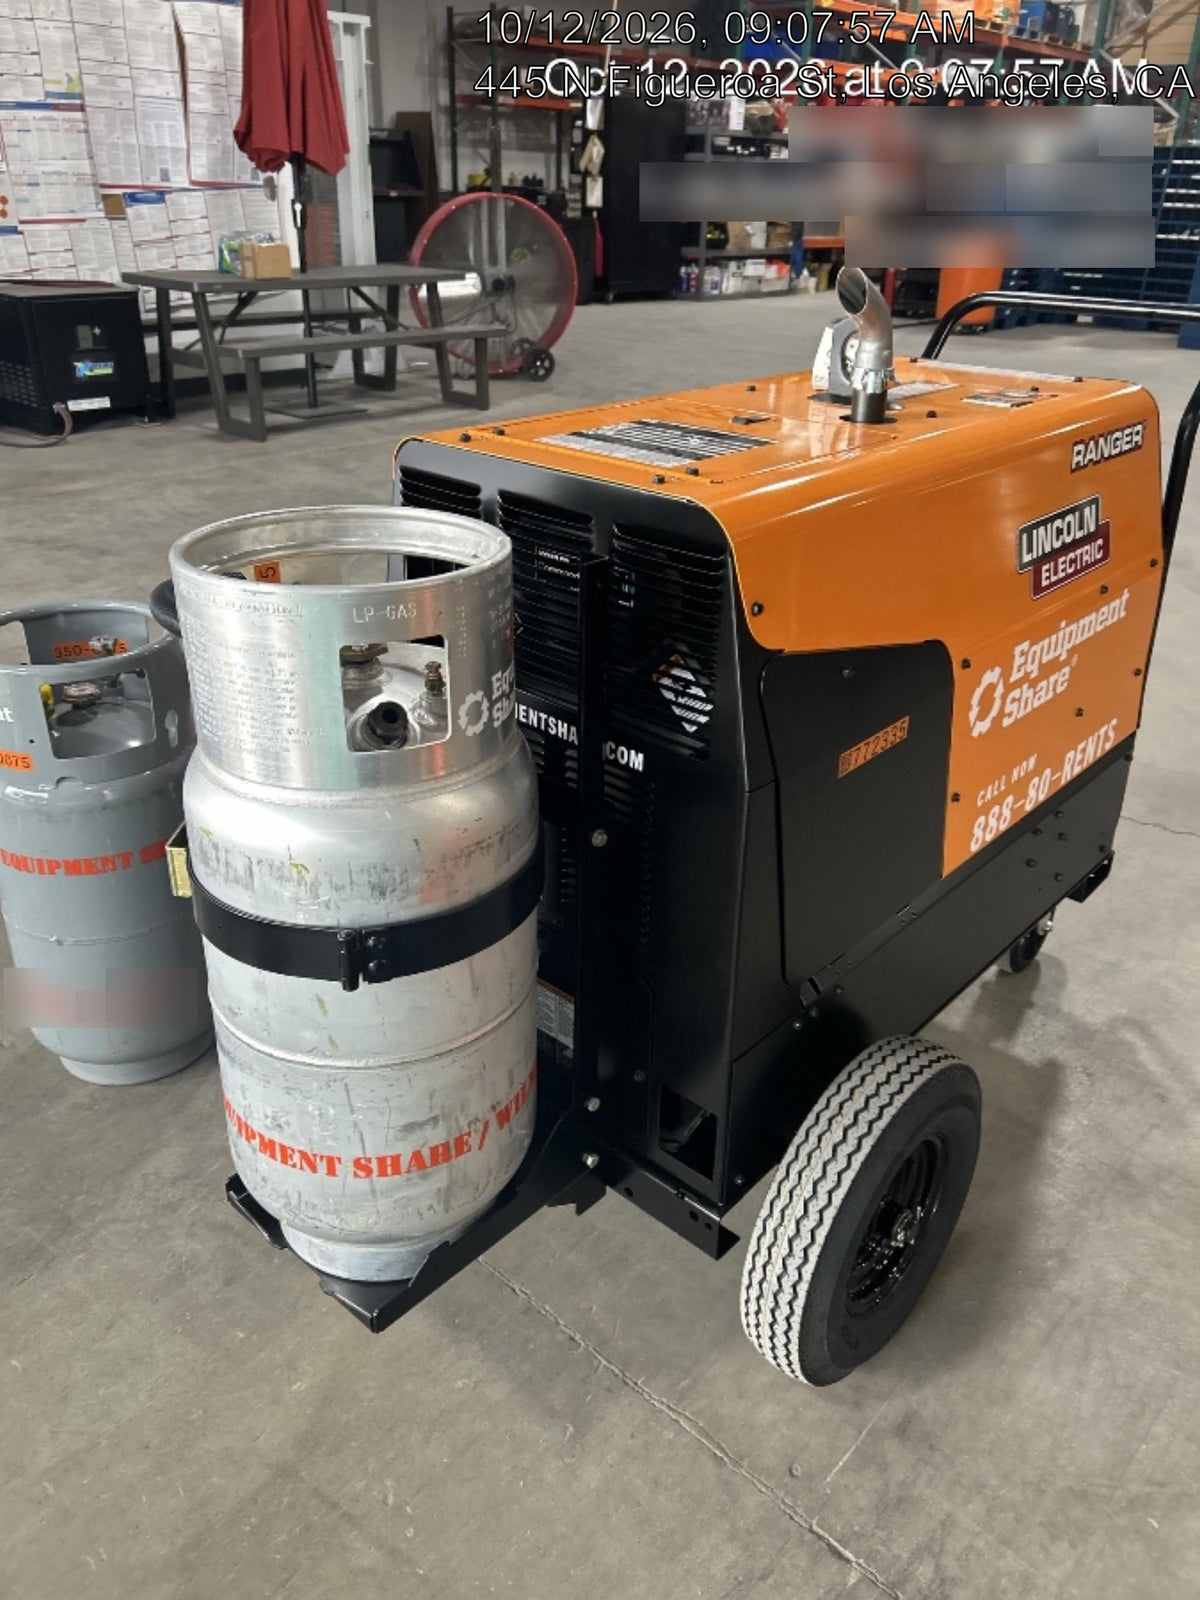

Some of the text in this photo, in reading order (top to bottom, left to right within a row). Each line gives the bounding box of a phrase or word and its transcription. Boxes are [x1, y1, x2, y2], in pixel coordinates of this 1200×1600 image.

[1071, 423, 1144, 470] RANGER
[1021, 503, 1097, 564] LINCOLN
[1041, 538, 1104, 587] ELECTRIC
[352, 603, 417, 624] LP-GAS
[1009, 588, 1130, 685] Equipment
[970, 717, 1118, 853] 888-80-RENTS
[977, 753, 1038, 808] CALL NOW
